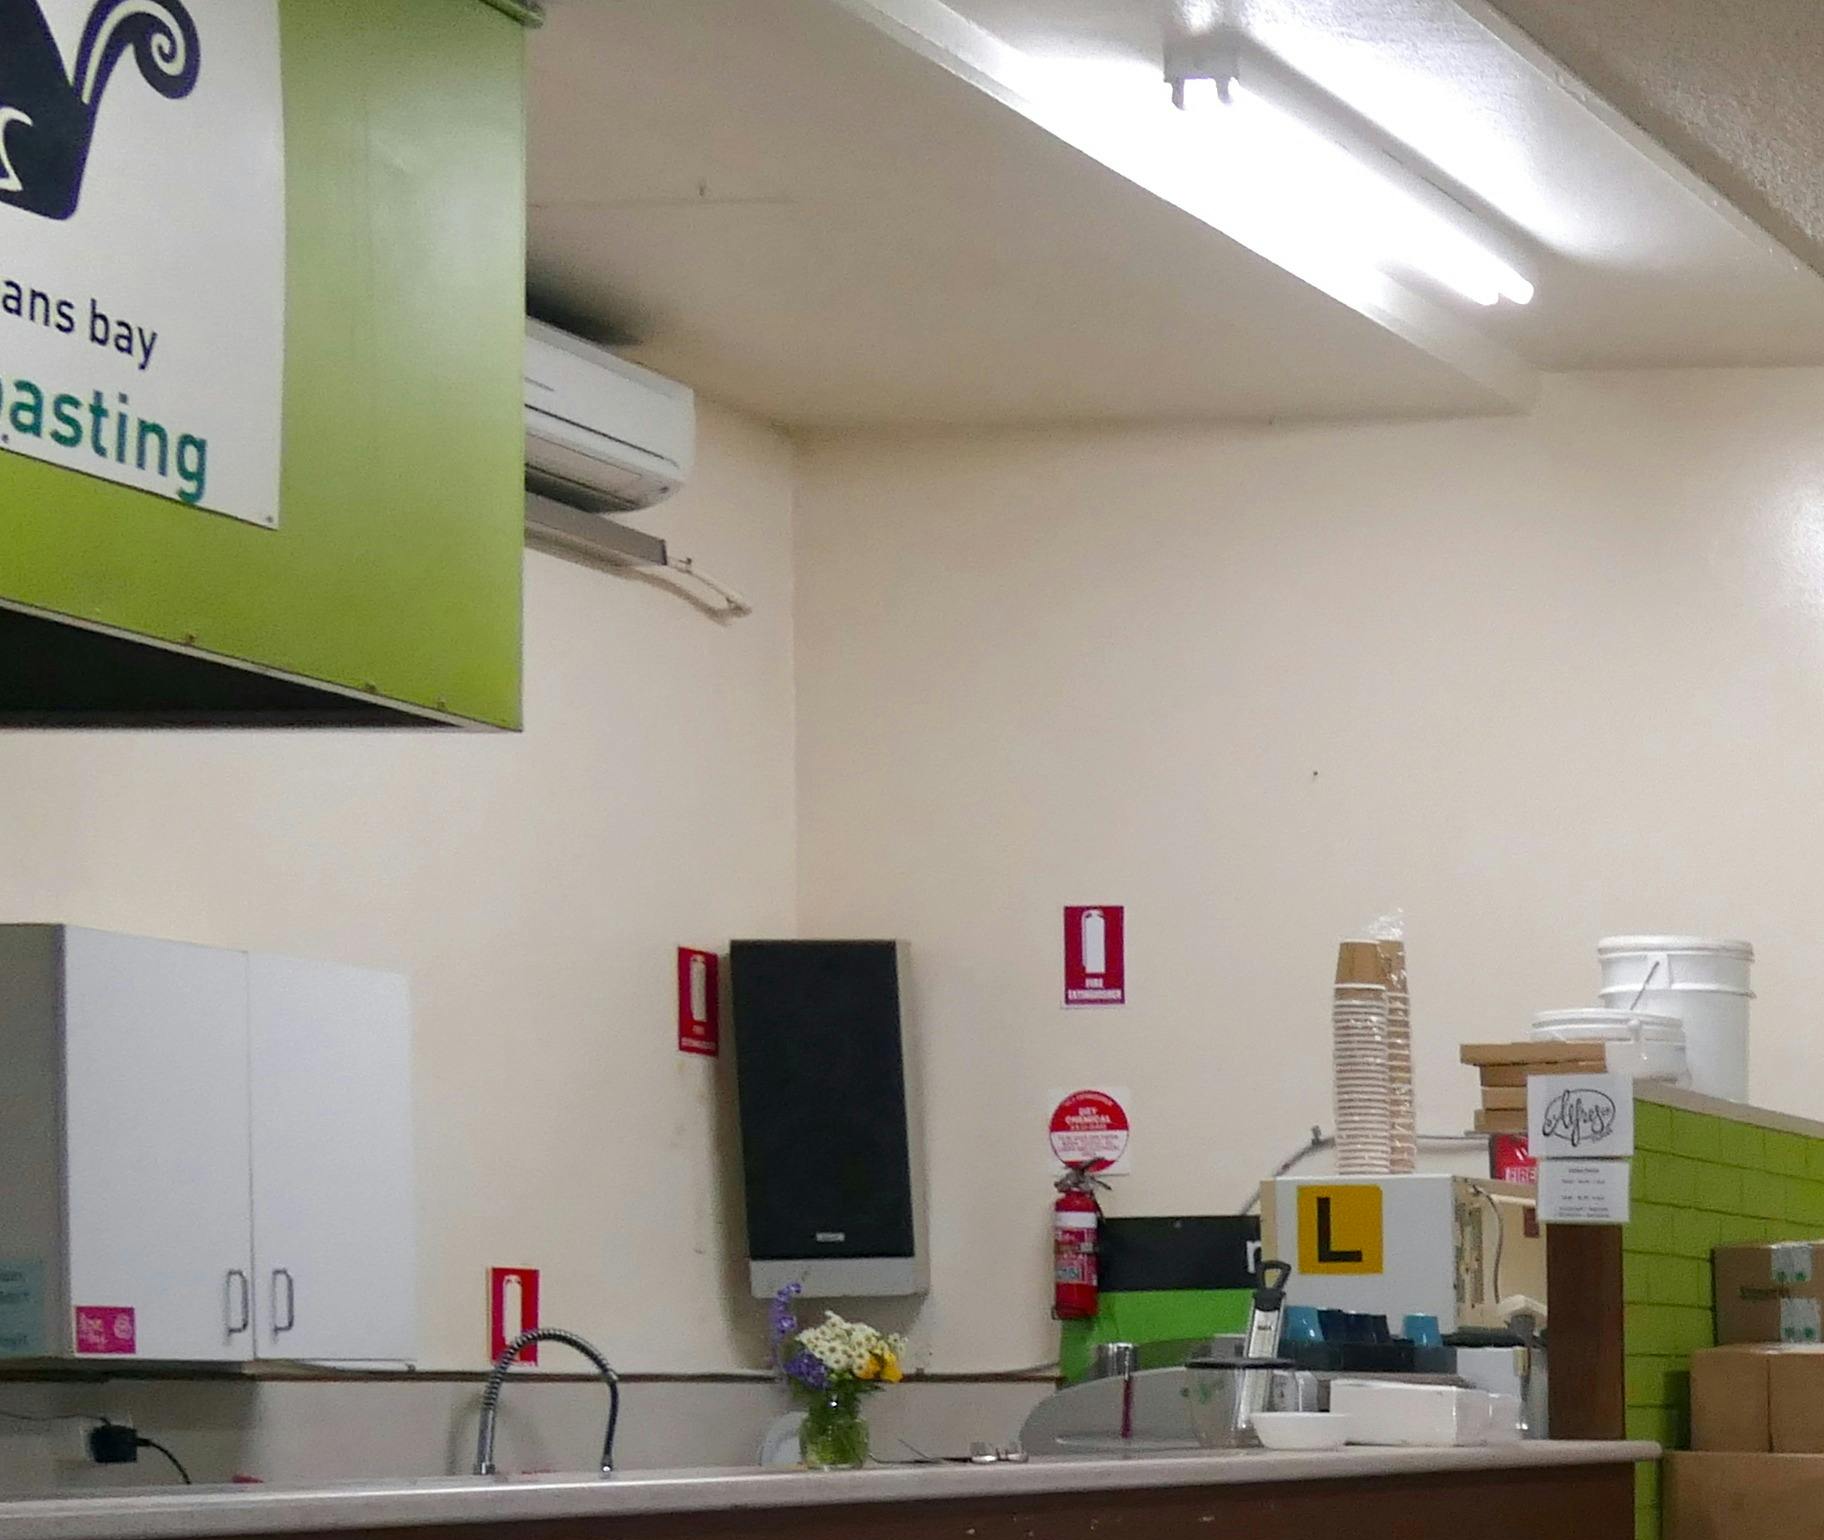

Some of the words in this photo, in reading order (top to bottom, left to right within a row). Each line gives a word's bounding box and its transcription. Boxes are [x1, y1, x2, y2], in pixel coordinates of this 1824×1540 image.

[90, 298, 158, 370] bay
[0, 378, 208, 504] asting
[1504, 1167, 1537, 1184] FIRE
[1316, 1196, 1362, 1263] L
